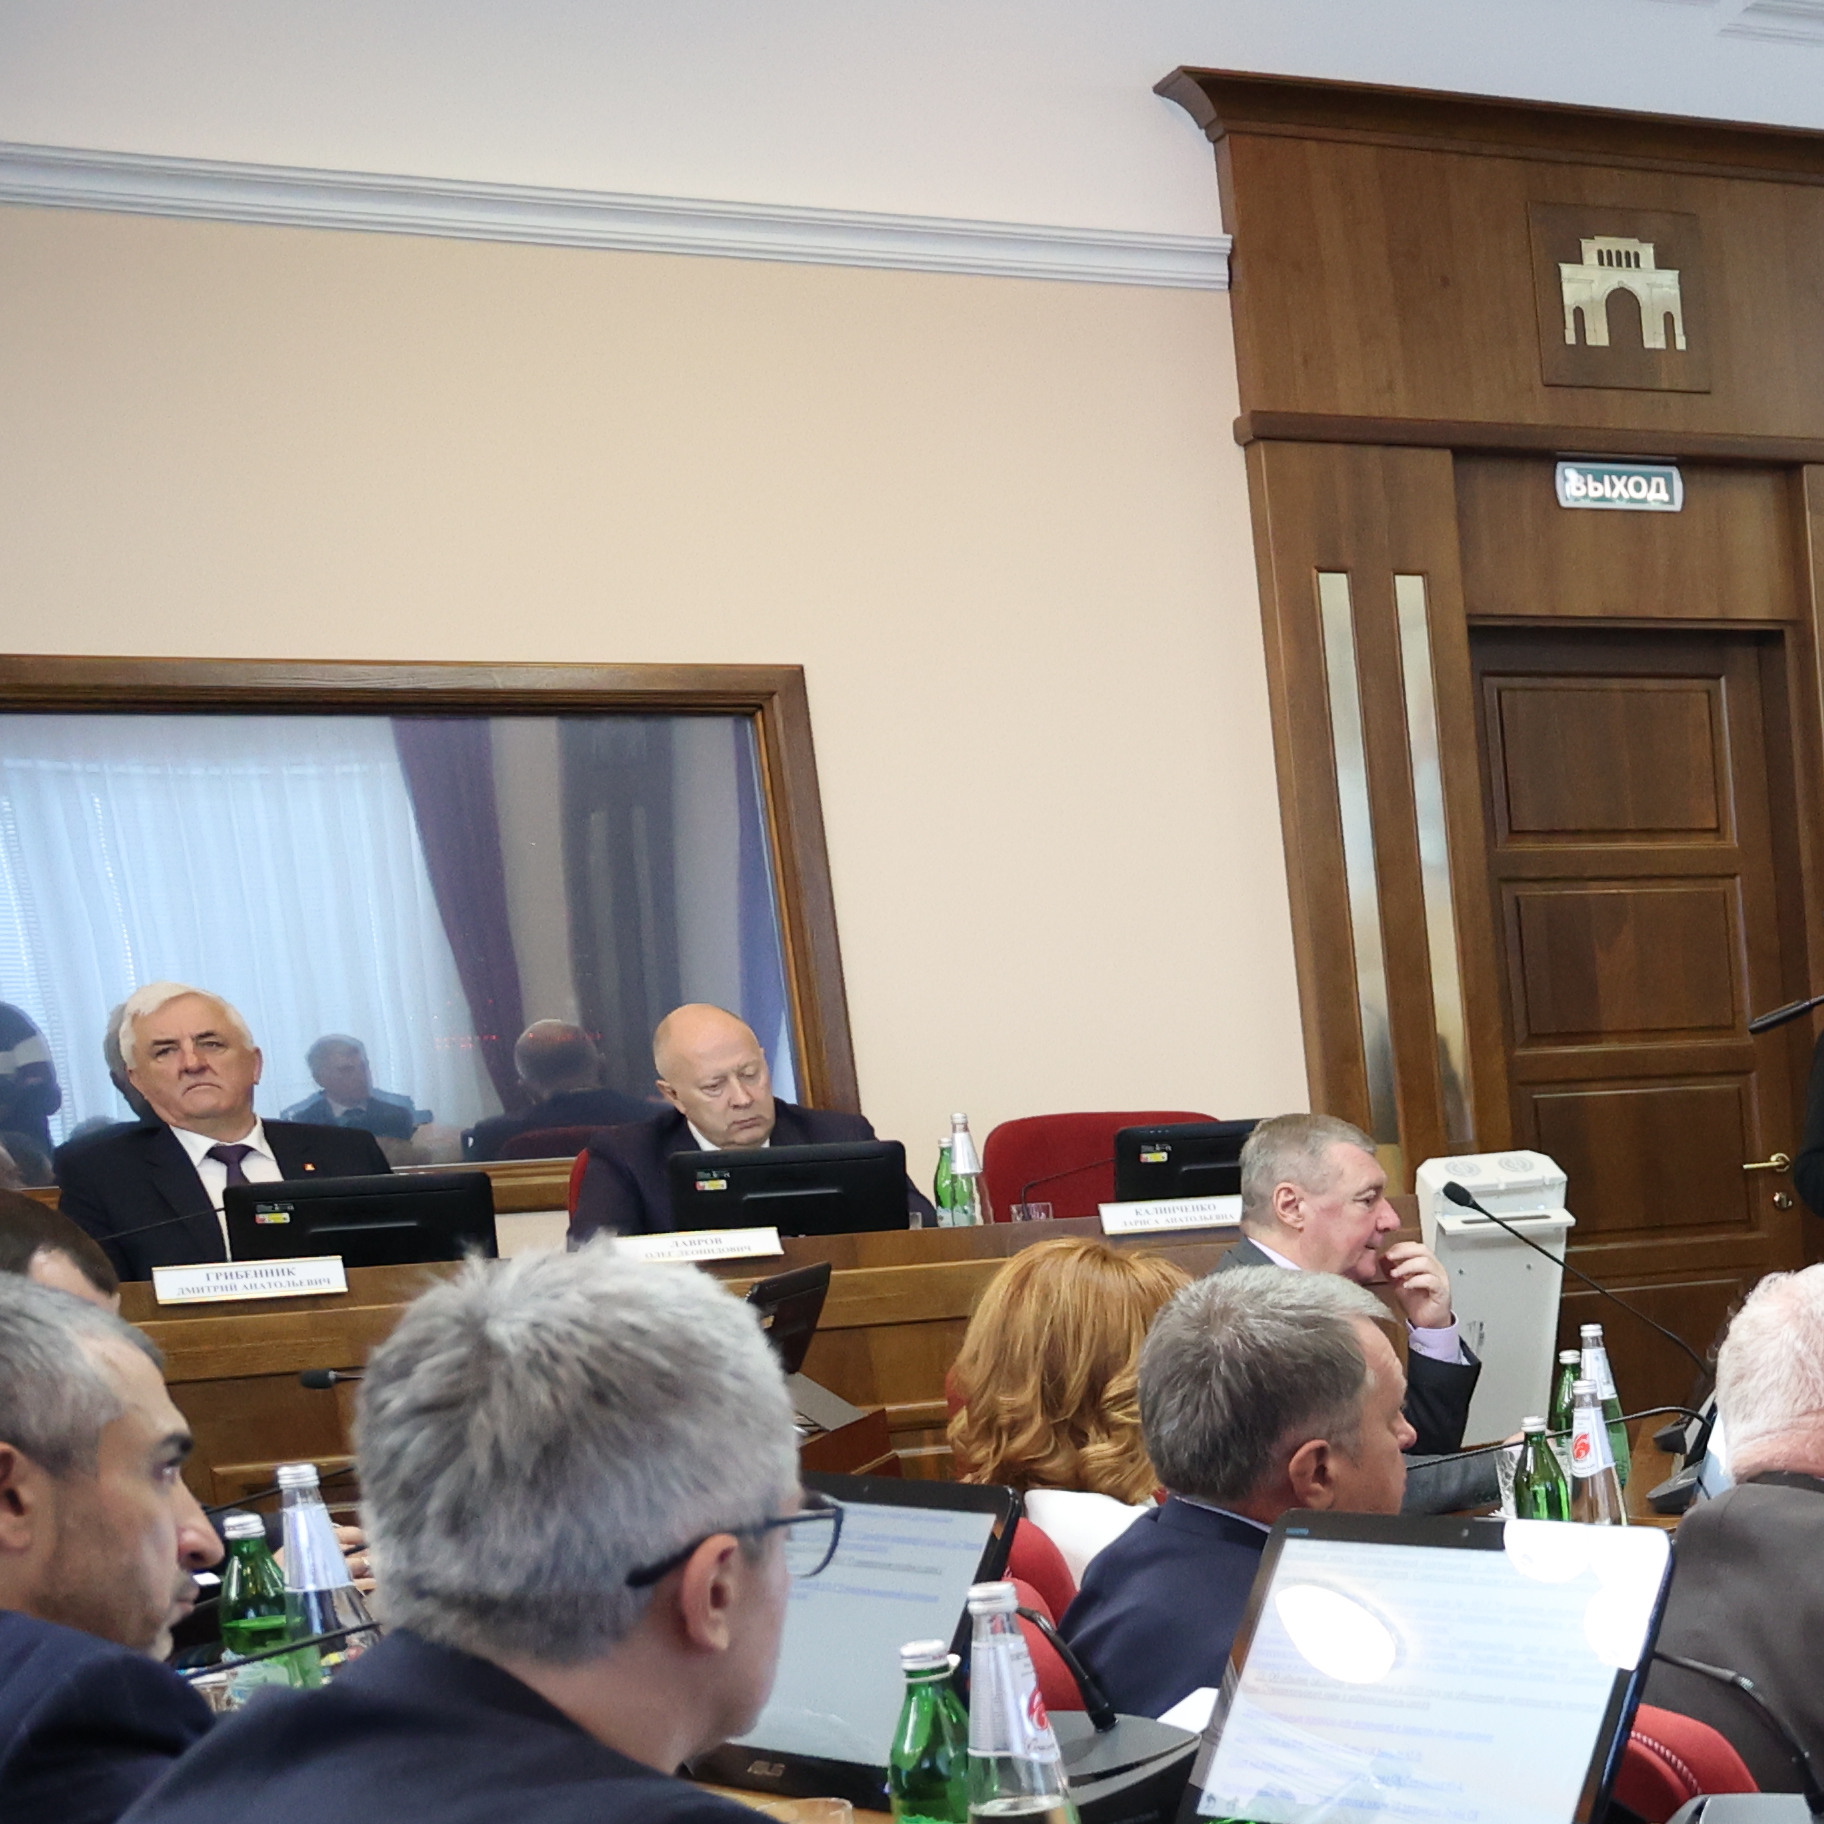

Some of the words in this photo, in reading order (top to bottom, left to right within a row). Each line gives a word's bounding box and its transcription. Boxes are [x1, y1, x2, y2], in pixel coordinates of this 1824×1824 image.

[1568, 473, 1670, 502] ВЫХОД
[670, 1237, 723, 1248] ЛАВРОВ
[205, 1266, 297, 1282] ГРИБЕННИК
[177, 1282, 239, 1296] ДМИТРИЙ
[241, 1277, 331, 1291] АНАТОЛЬЕВИЧ
